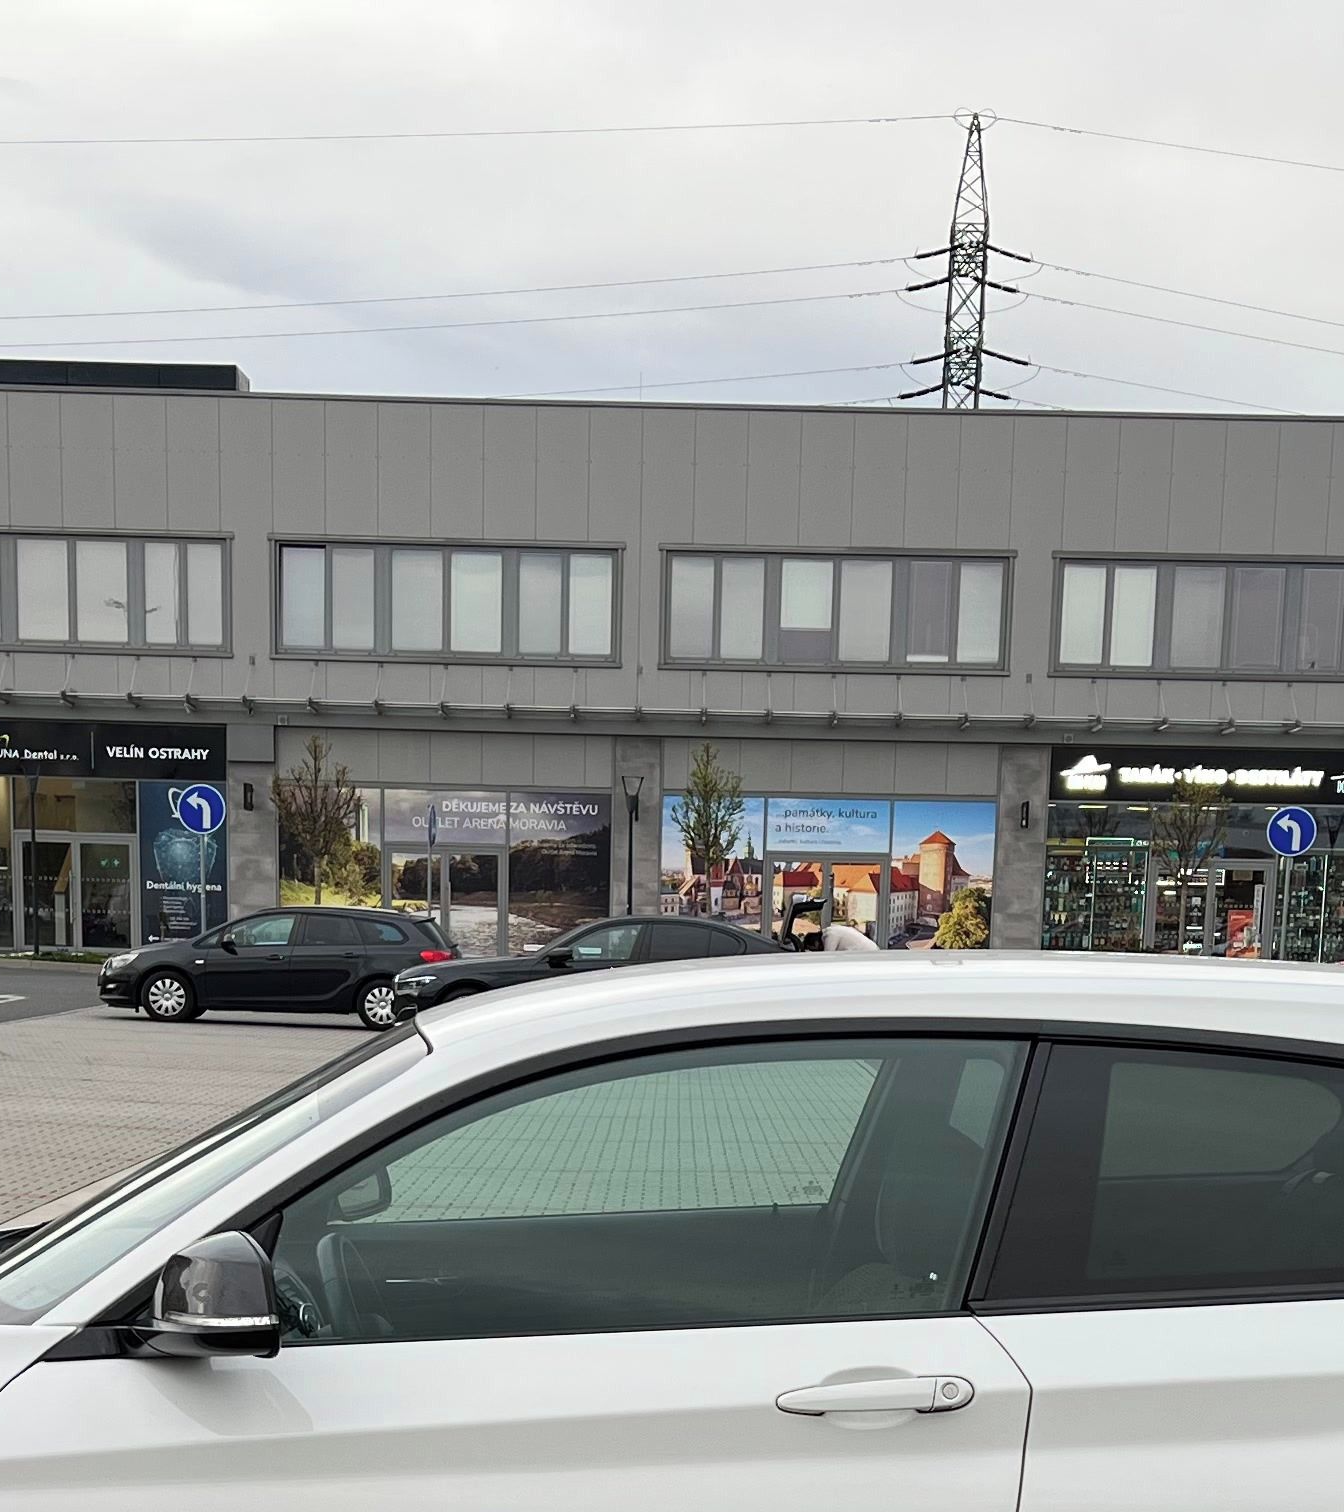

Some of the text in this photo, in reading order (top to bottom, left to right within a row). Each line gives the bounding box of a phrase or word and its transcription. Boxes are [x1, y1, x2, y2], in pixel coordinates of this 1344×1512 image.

[24, 749, 58, 760] Dental
[106, 744, 210, 761] VELÍN OSTRAHY
[442, 799, 599, 816] DĚKUJEME ZA NÁVŠTĚVU
[838, 808, 878, 819] kultura
[412, 816, 568, 831] OULET ARENA MORAVIA
[775, 824, 782, 833] a
[186, 881, 222, 893] hygena
